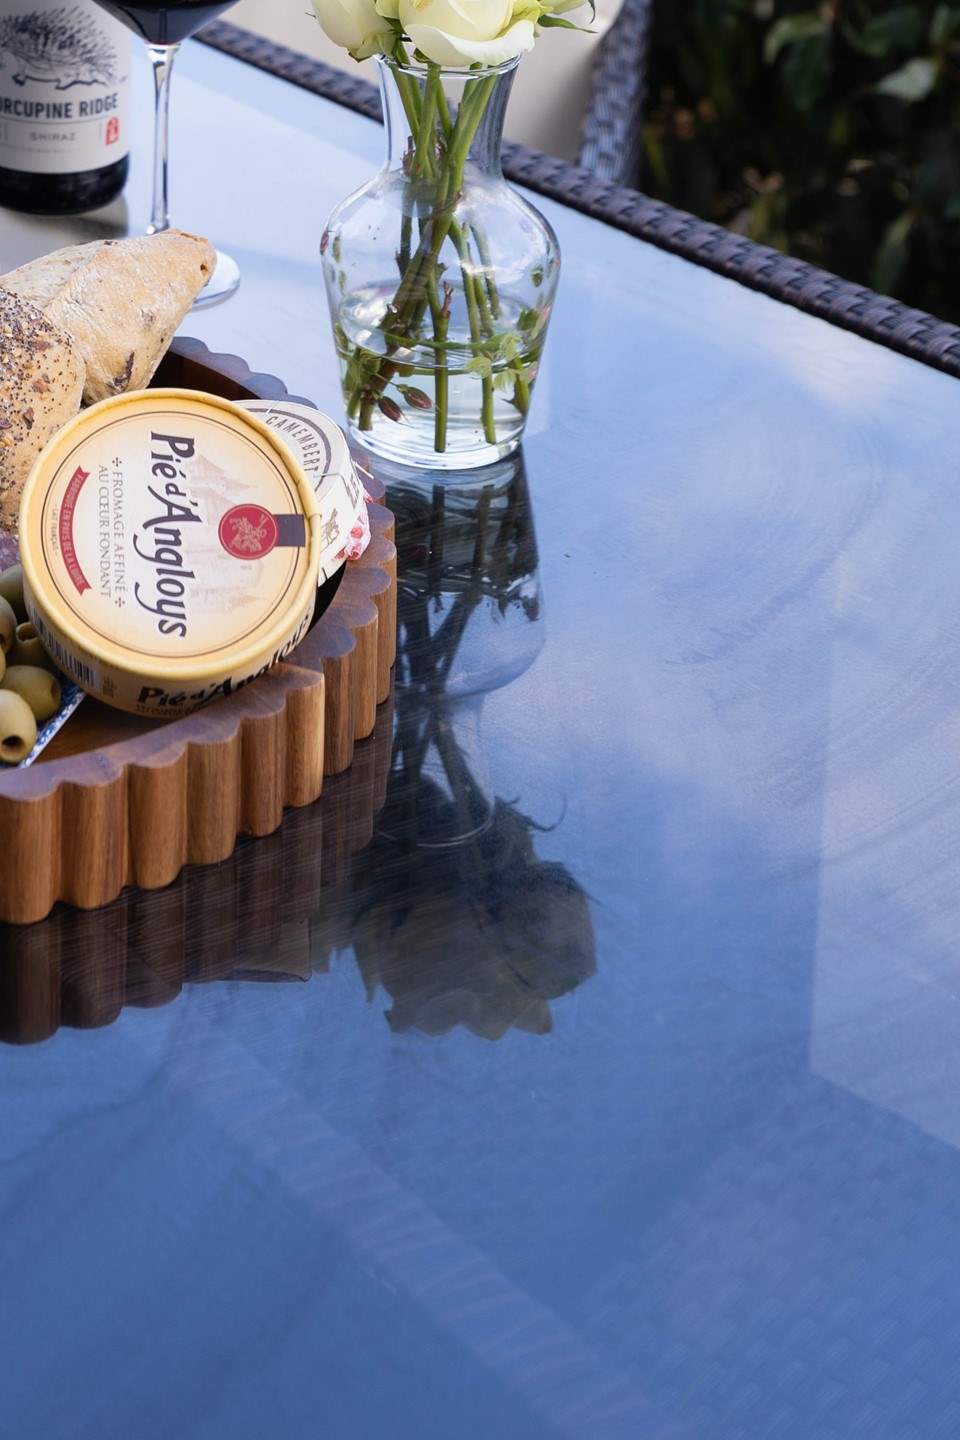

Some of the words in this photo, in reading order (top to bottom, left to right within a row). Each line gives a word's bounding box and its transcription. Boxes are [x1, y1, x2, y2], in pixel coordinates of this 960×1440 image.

[79, 93, 118, 117] RIDGE
[29, 132, 77, 142] SHIRAZ
[151, 431, 195, 479] Pié
[266, 415, 321, 472] CAMEMBERT
[99, 464, 109, 483] AU
[99, 486, 110, 528] CŒUR
[112, 471, 124, 539] FROMAGE
[99, 532, 112, 599] FONDANT
[114, 543, 129, 593] AFFINÉ
[133, 482, 203, 638] d'Angloys
